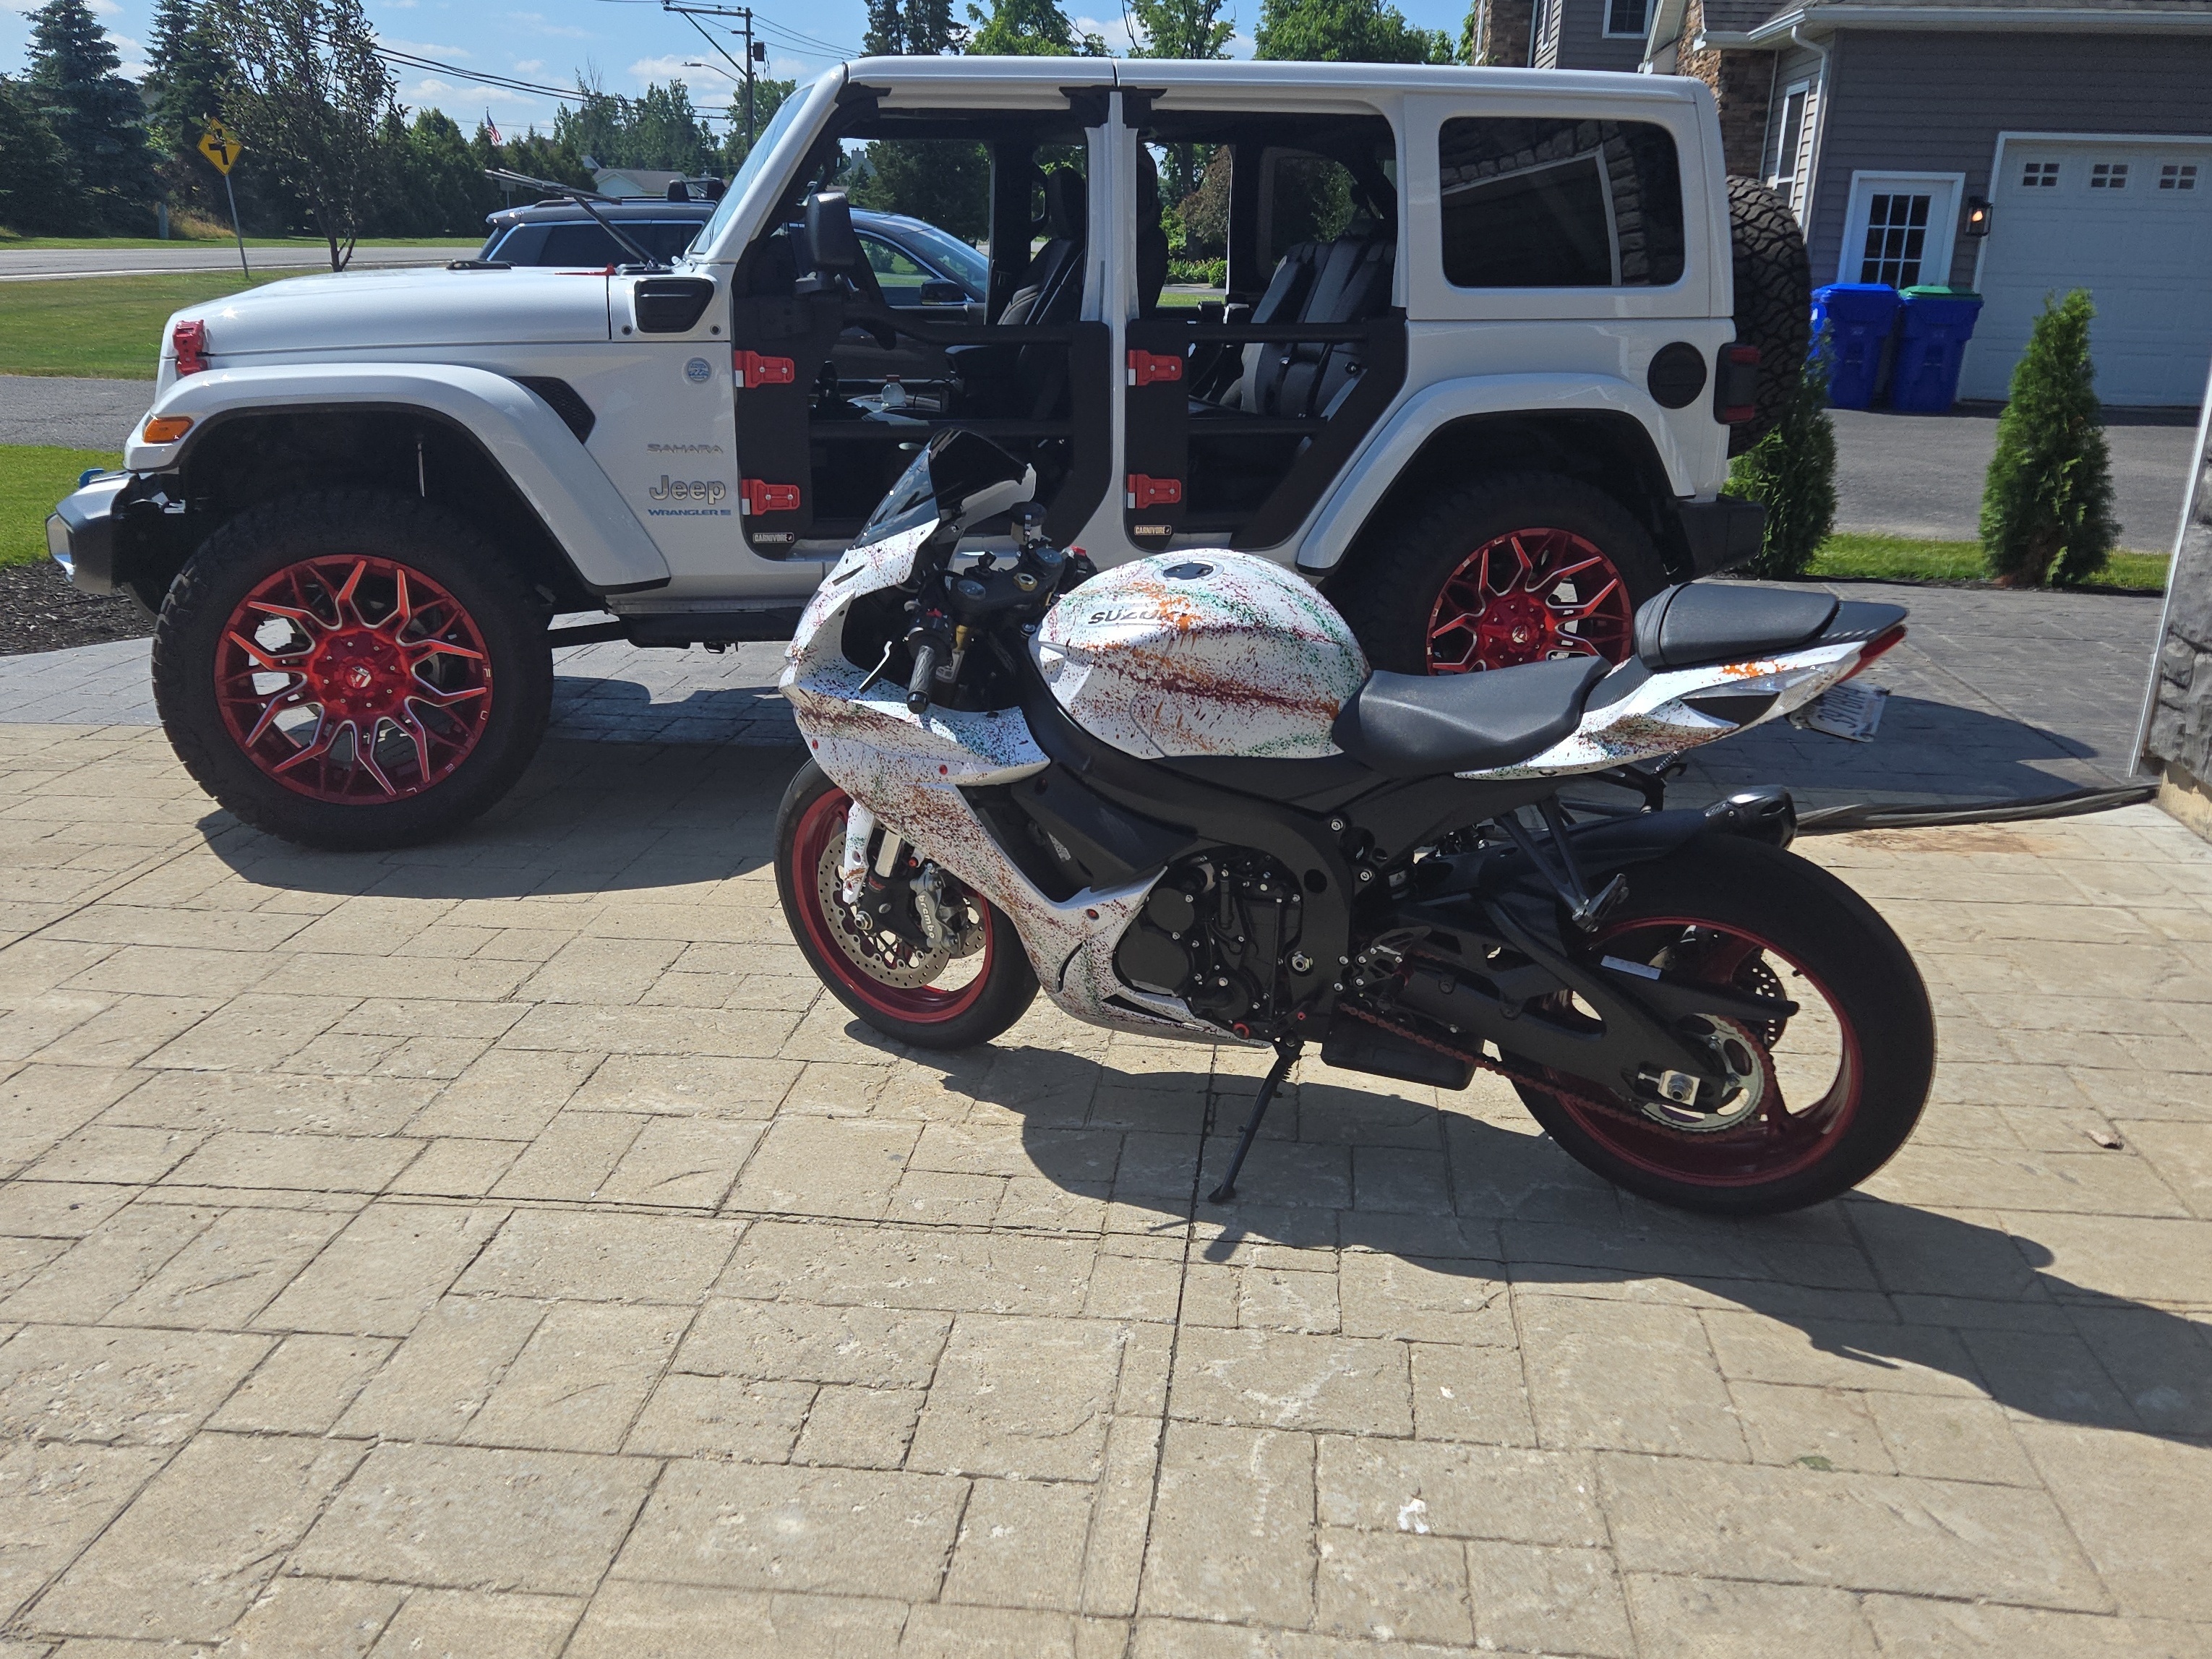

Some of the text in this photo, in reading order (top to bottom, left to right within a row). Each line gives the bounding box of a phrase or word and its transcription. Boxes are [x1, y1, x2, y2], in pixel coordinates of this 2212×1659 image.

[648, 444, 723, 453] SAHARA
[649, 475, 726, 505] Jeep
[918, 895, 934, 938] brembo
